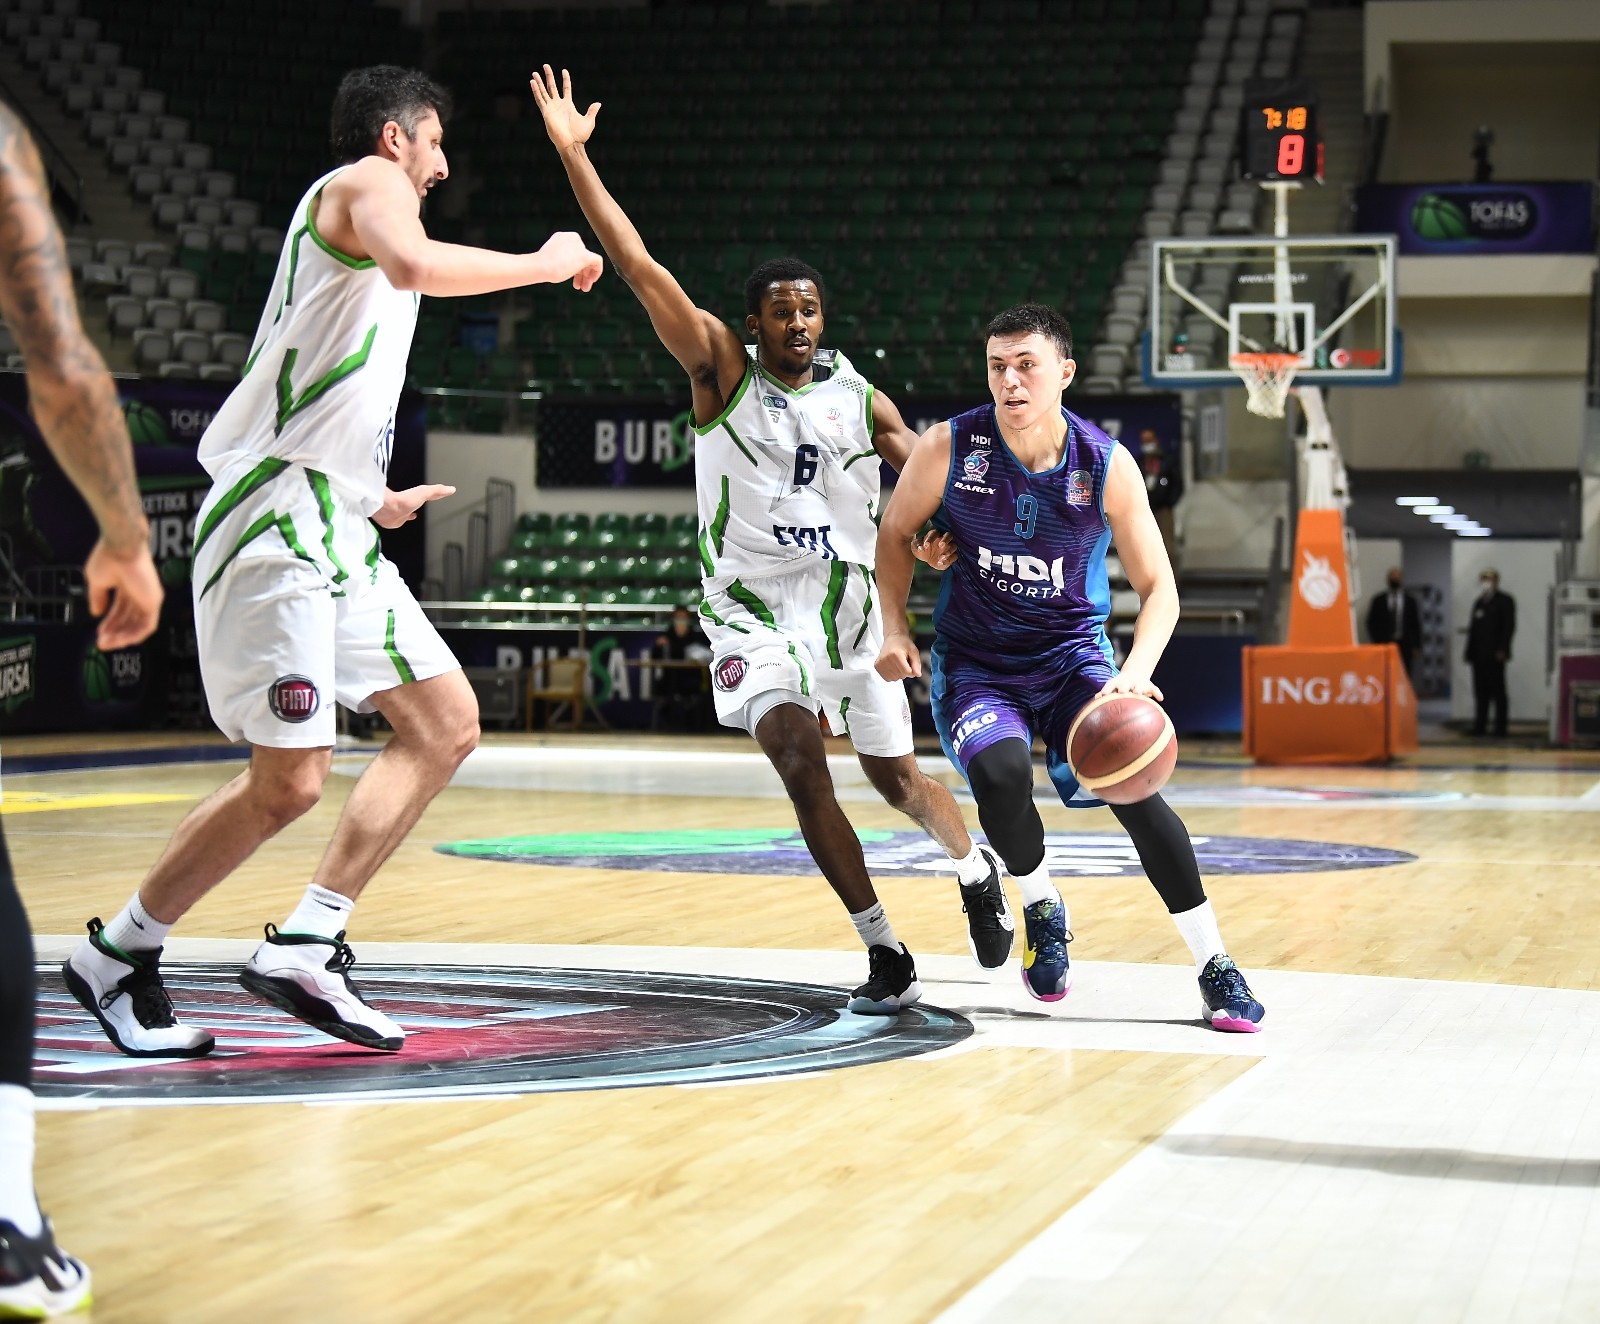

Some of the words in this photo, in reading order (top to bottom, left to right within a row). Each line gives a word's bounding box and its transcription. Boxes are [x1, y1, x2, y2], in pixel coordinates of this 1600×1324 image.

[1262, 106, 1307, 130] 7:18
[1278, 134, 1305, 175] 8
[171, 409, 217, 431] TOFA
[970, 434, 992, 446] HDI
[794, 443, 819, 486] 6
[954, 481, 997, 495] BAREX
[1014, 493, 1039, 539] 9
[978, 545, 1065, 590] HDI
[721, 659, 745, 685] FIAT
[281, 689, 312, 710] FIAT
[1261, 675, 1331, 705] ING
